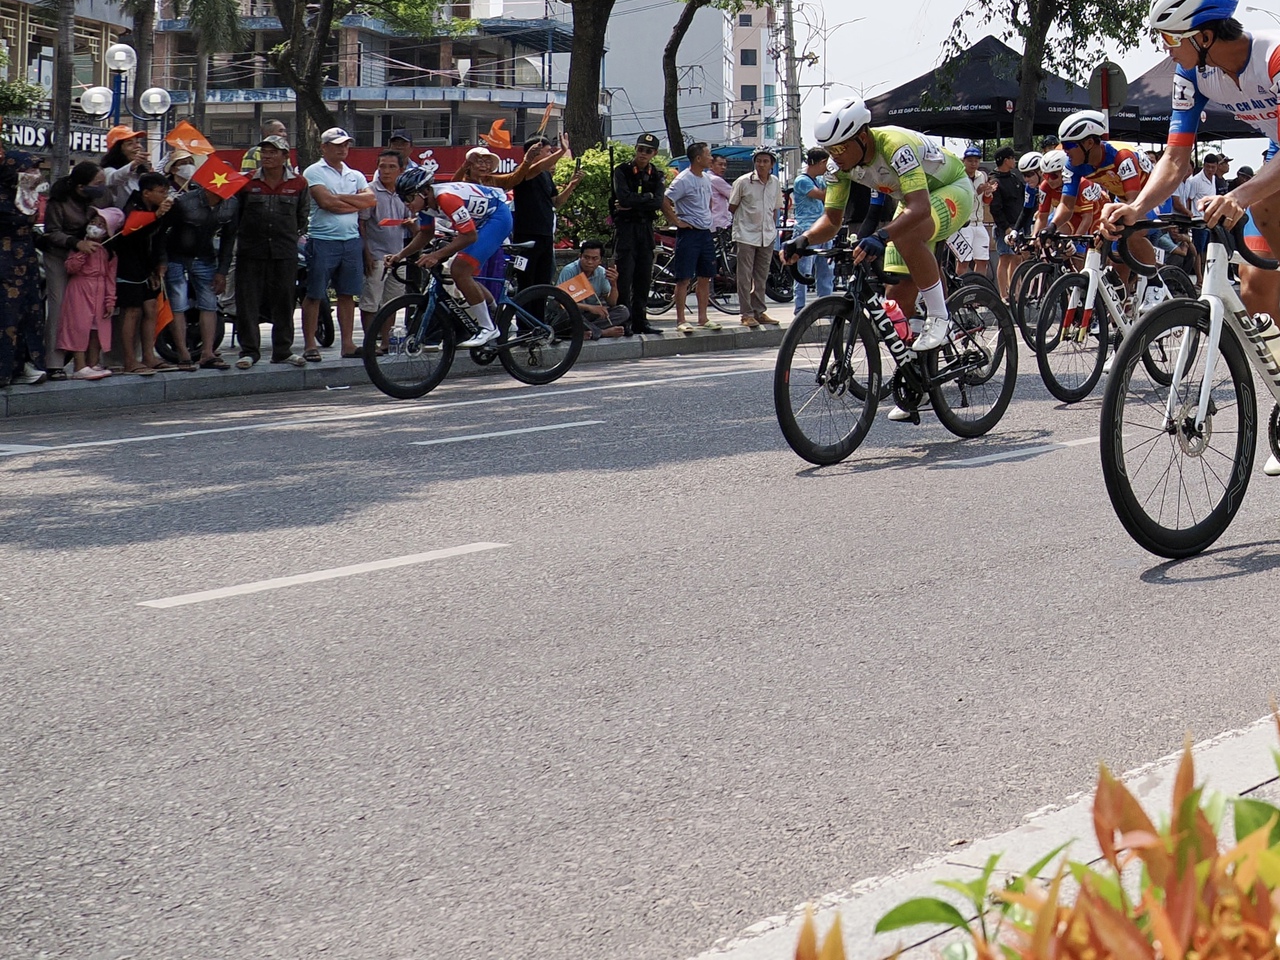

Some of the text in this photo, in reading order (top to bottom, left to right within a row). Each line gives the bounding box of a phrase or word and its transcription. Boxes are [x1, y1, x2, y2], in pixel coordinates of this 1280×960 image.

[894, 148, 914, 170] 143
[457, 210, 467, 220] 15
[471, 200, 486, 214] 15
[951, 234, 969, 256] 143
[514, 257, 523, 266] 15
[867, 292, 918, 367] FACTOR
